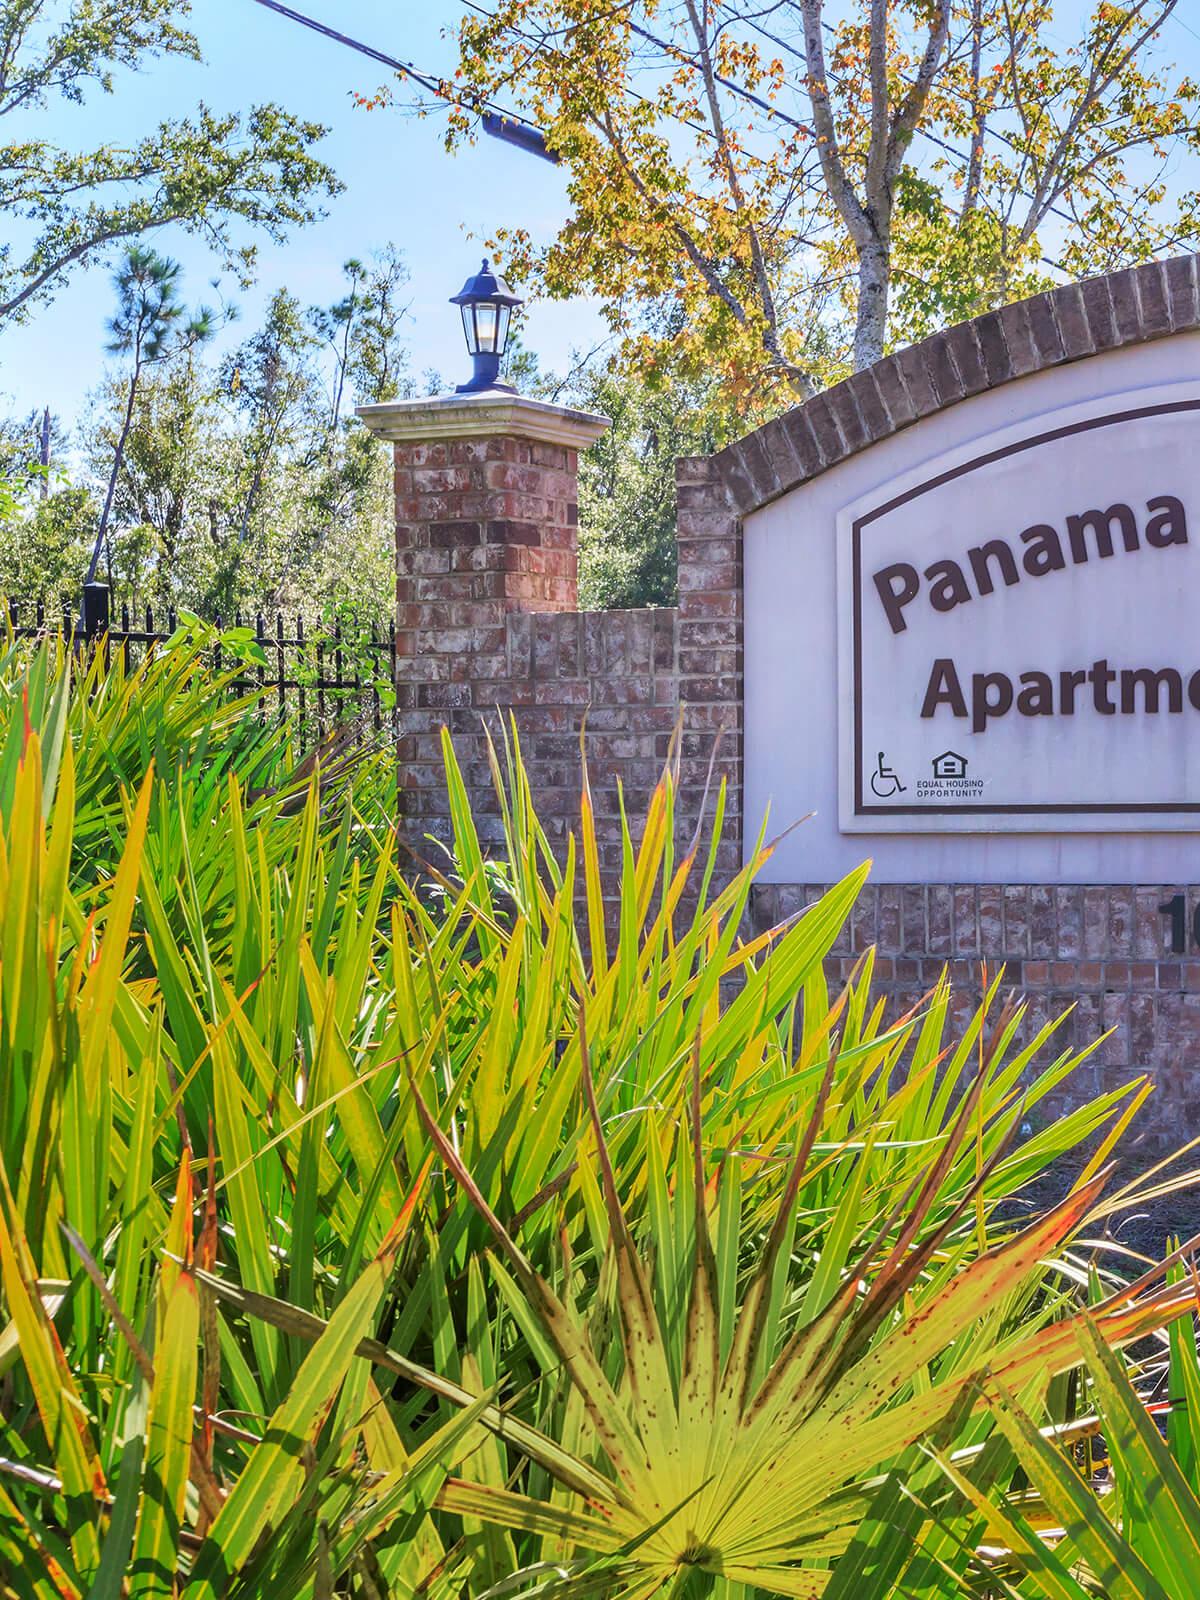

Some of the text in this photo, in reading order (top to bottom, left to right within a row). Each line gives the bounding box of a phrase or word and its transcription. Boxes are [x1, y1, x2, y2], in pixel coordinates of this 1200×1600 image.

[872, 495, 1189, 635] Panama
[917, 780, 944, 788] EQUAL
[917, 789, 983, 797] OPPORTUNITY
